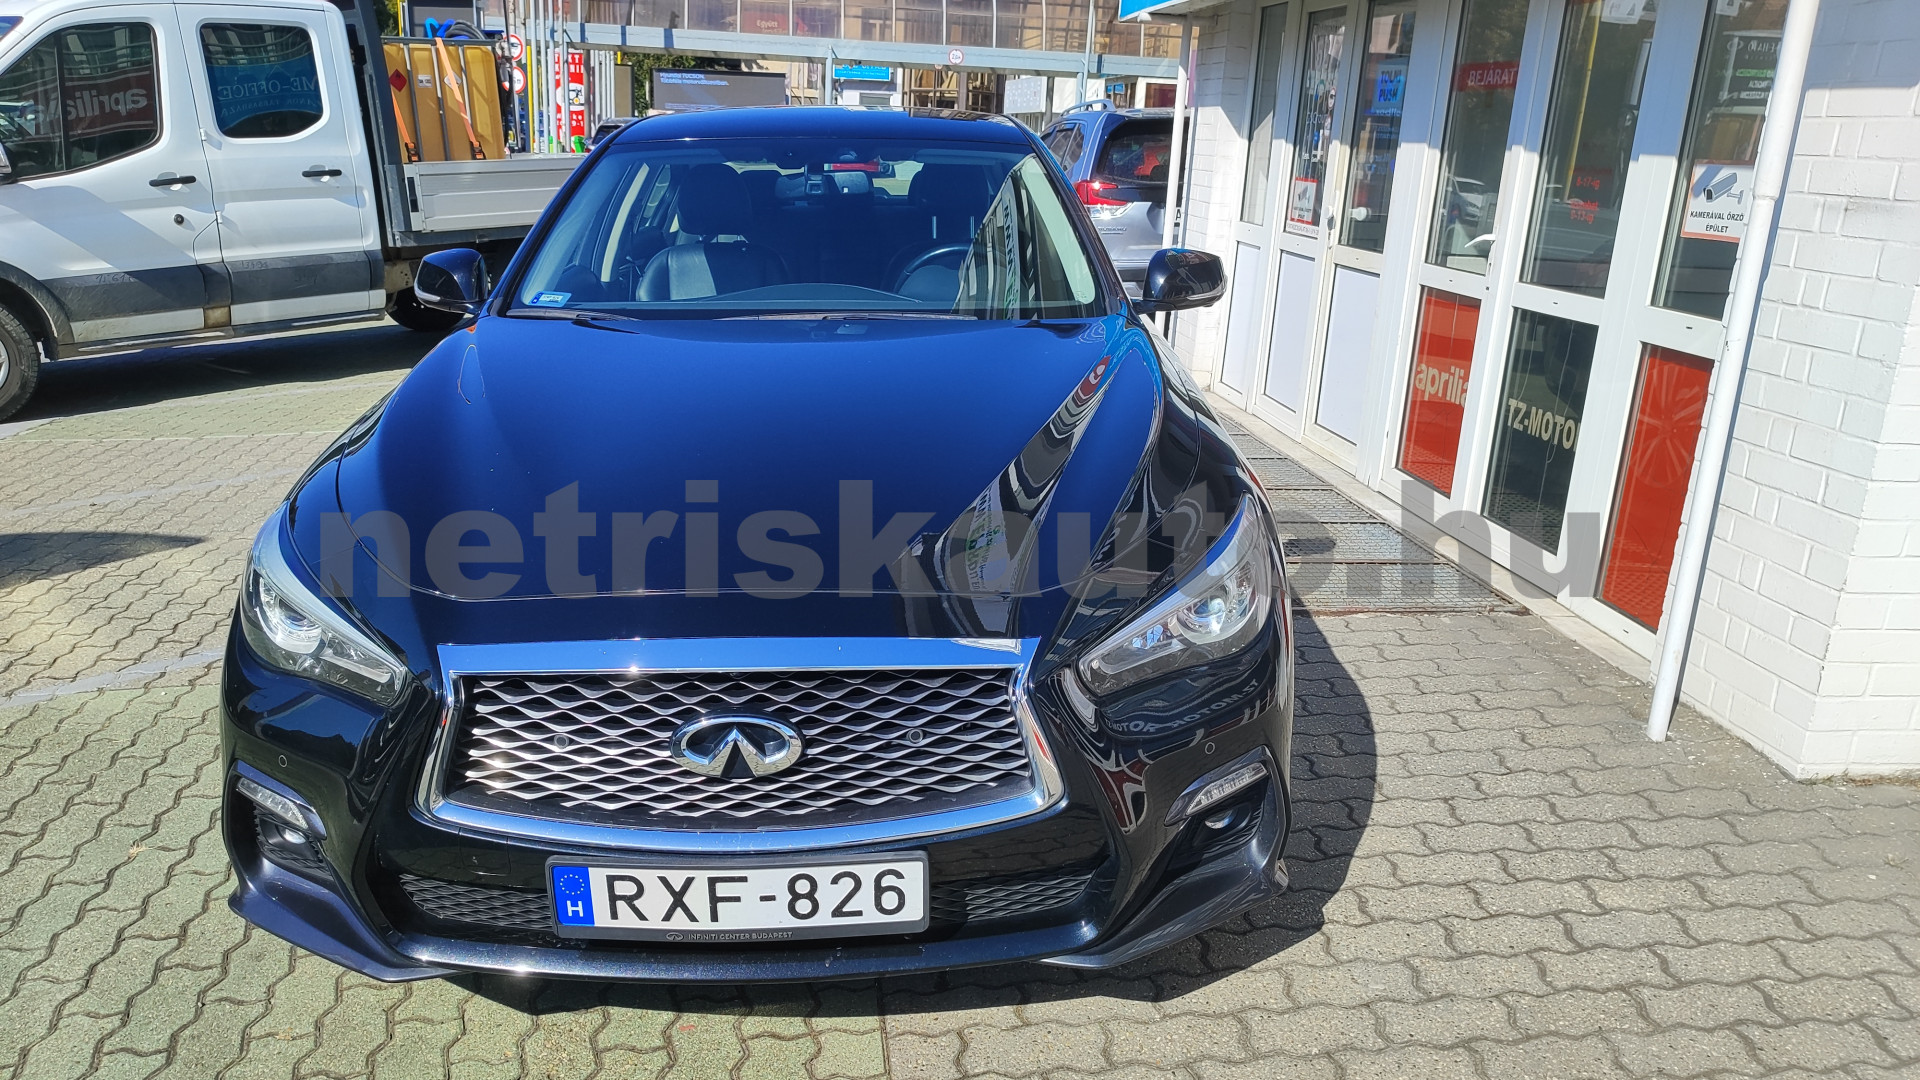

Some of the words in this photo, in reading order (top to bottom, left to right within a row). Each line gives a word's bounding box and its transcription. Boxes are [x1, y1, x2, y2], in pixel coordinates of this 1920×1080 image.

[1468, 65, 1517, 86] BEJÁRAT
[1378, 87, 1399, 102] PUSH
[1689, 210, 1725, 220] KAMERÁVAL
[1705, 222, 1729, 234] ÉPÜLET
[605, 868, 906, 923] RXF-826
[567, 900, 584, 918] H
[752, 931, 793, 939] BUDAPEST
